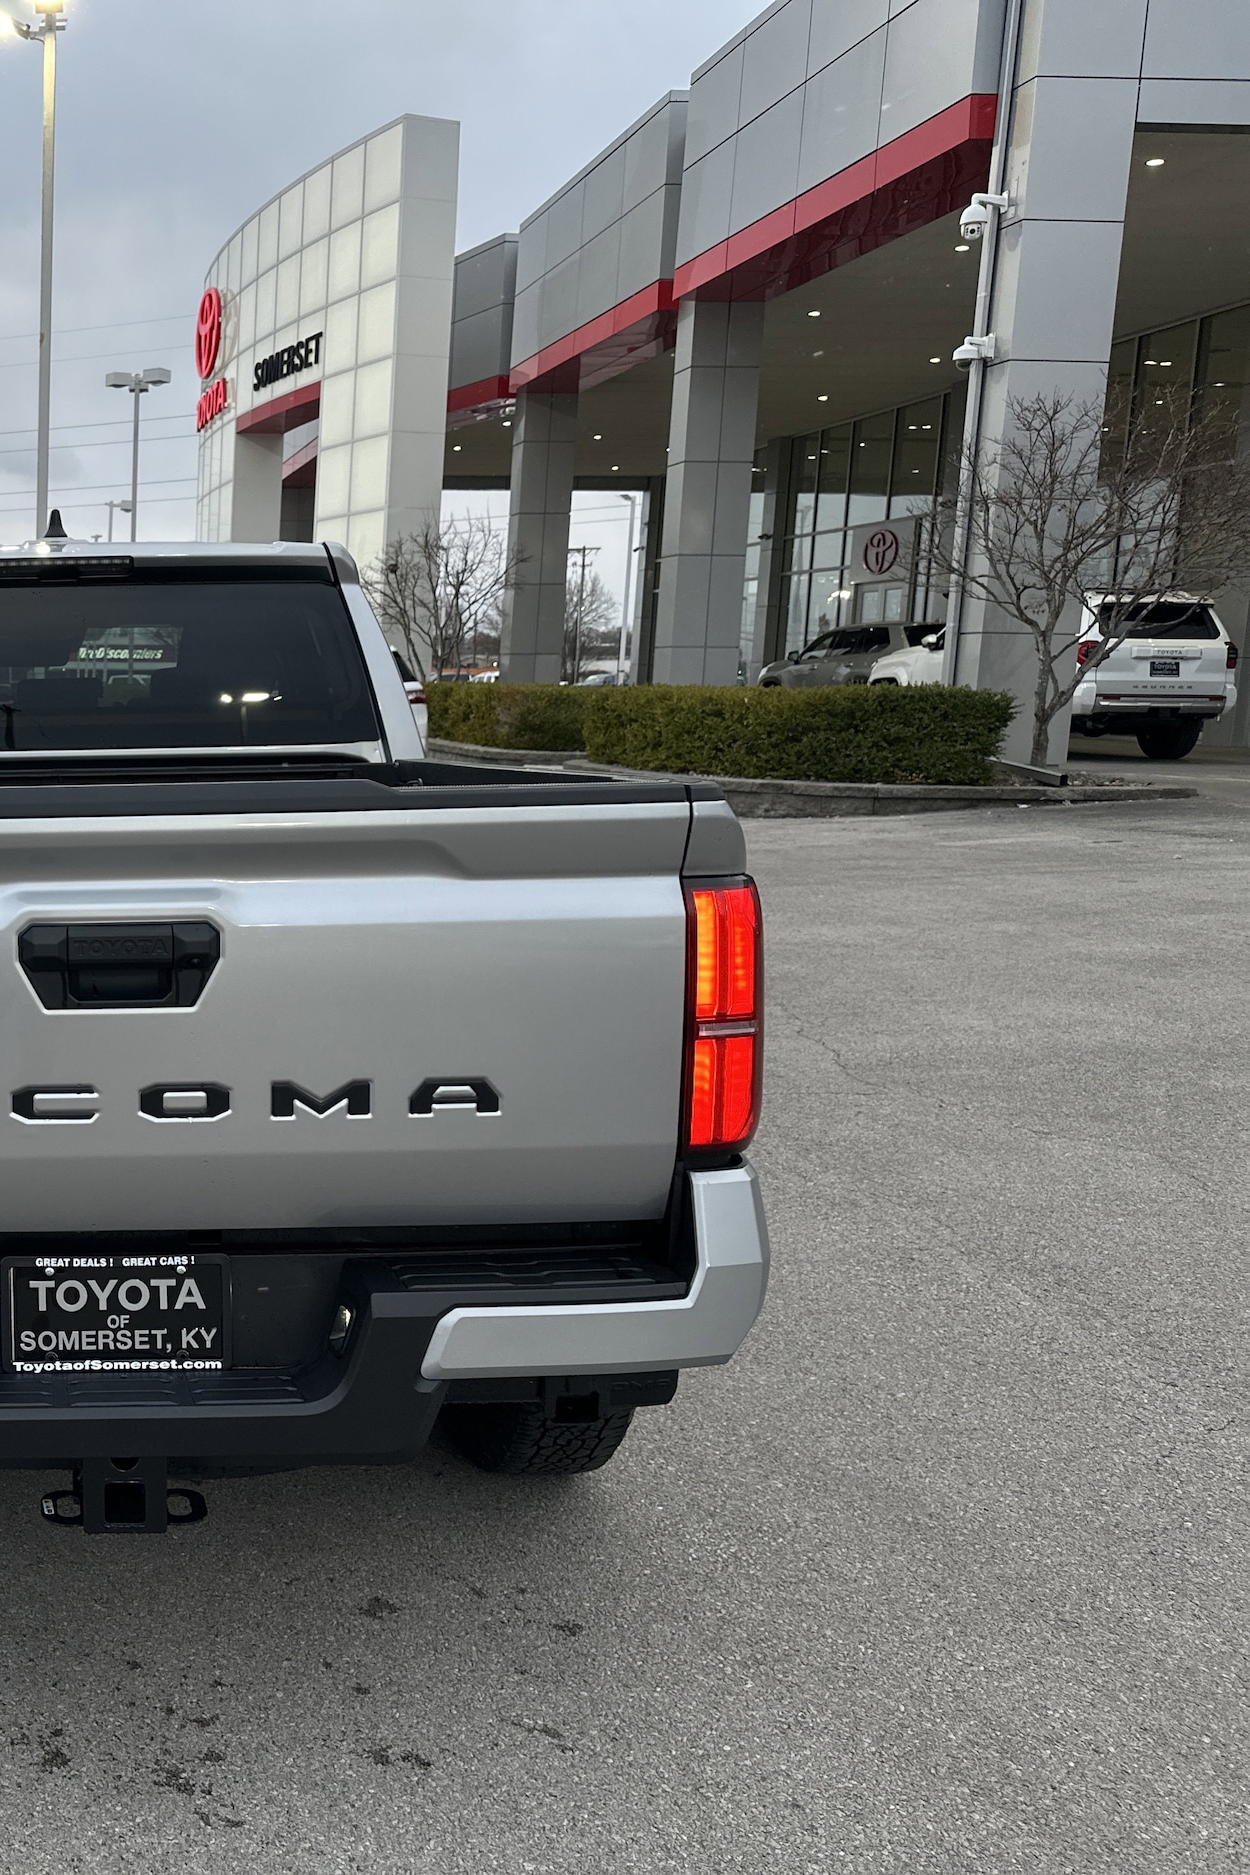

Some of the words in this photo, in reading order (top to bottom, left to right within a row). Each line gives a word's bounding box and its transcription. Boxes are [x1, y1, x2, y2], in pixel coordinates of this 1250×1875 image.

[253, 332, 323, 391] SOMERSET
[73, 939, 169, 957] TOYOTA
[35, 1257, 71, 1268] GREAT
[122, 1257, 158, 1267] GREAT
[29, 1278, 206, 1312] TOYOTA
[107, 1314, 130, 1329] OF
[20, 1328, 172, 1353] SOMERSET,
[181, 1327, 218, 1349] KY
[12, 1360, 223, 1374] ToyotaofSomerset.com
